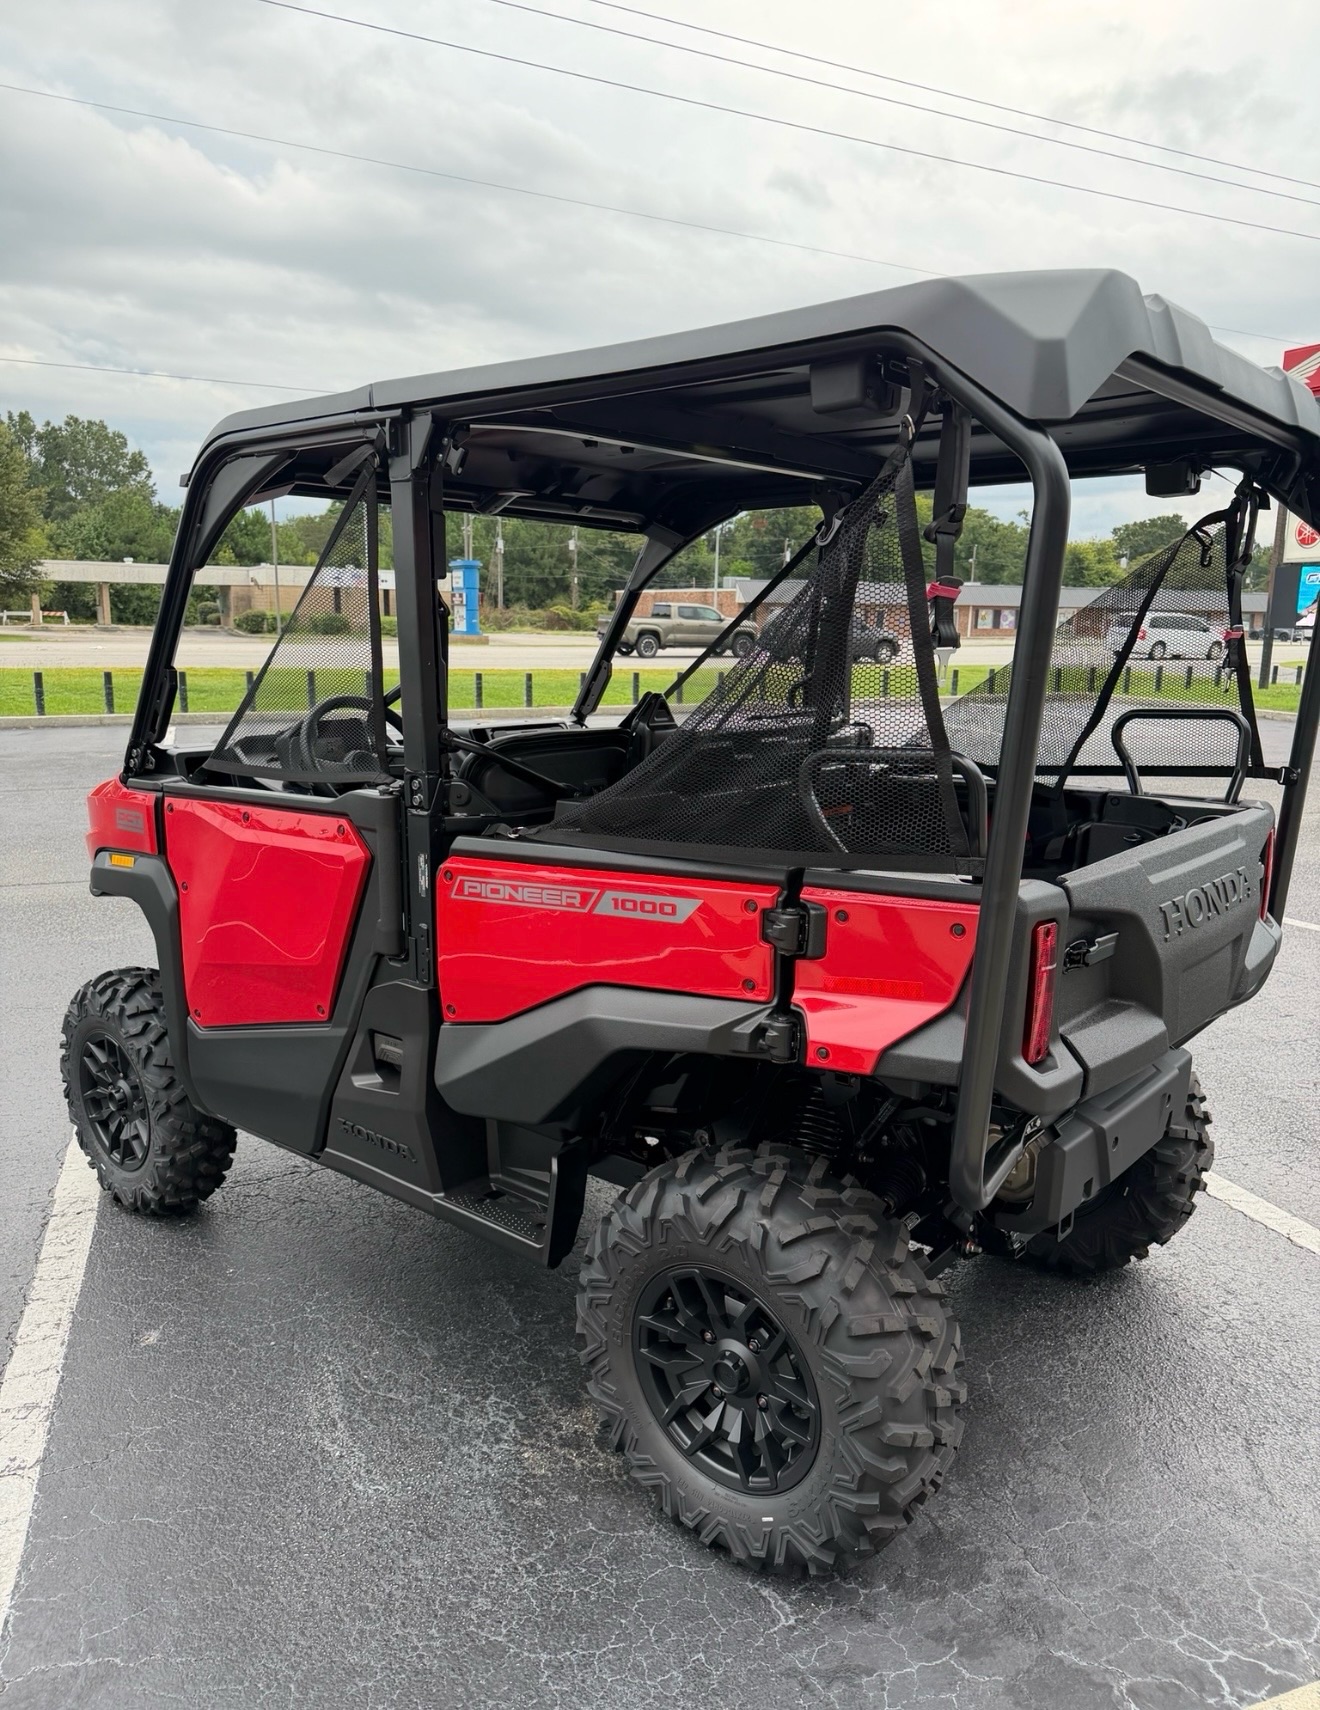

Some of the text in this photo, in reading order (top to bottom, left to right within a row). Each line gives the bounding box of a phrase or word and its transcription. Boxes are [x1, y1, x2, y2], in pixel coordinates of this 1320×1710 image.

[463, 881, 677, 917] PIONEER 1000
[1159, 865, 1257, 942] HONDA
[337, 1117, 417, 1163] HONDA
